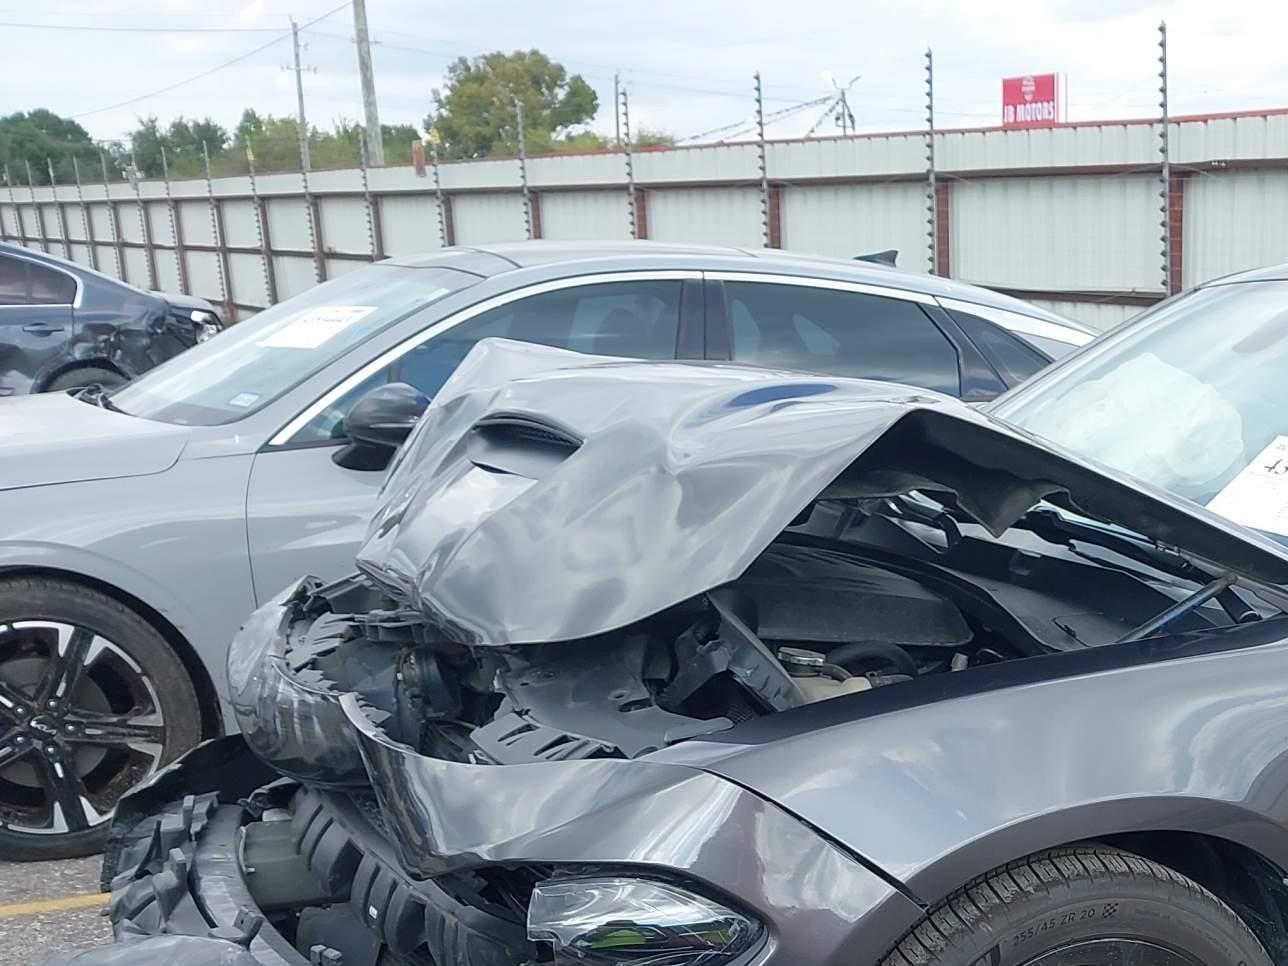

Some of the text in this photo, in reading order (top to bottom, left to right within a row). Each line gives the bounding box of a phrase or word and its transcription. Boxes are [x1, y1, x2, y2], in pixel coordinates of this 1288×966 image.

[1016, 101, 1054, 122] MOTORS
[1012, 907, 1096, 946] 255/45 ZR 20
